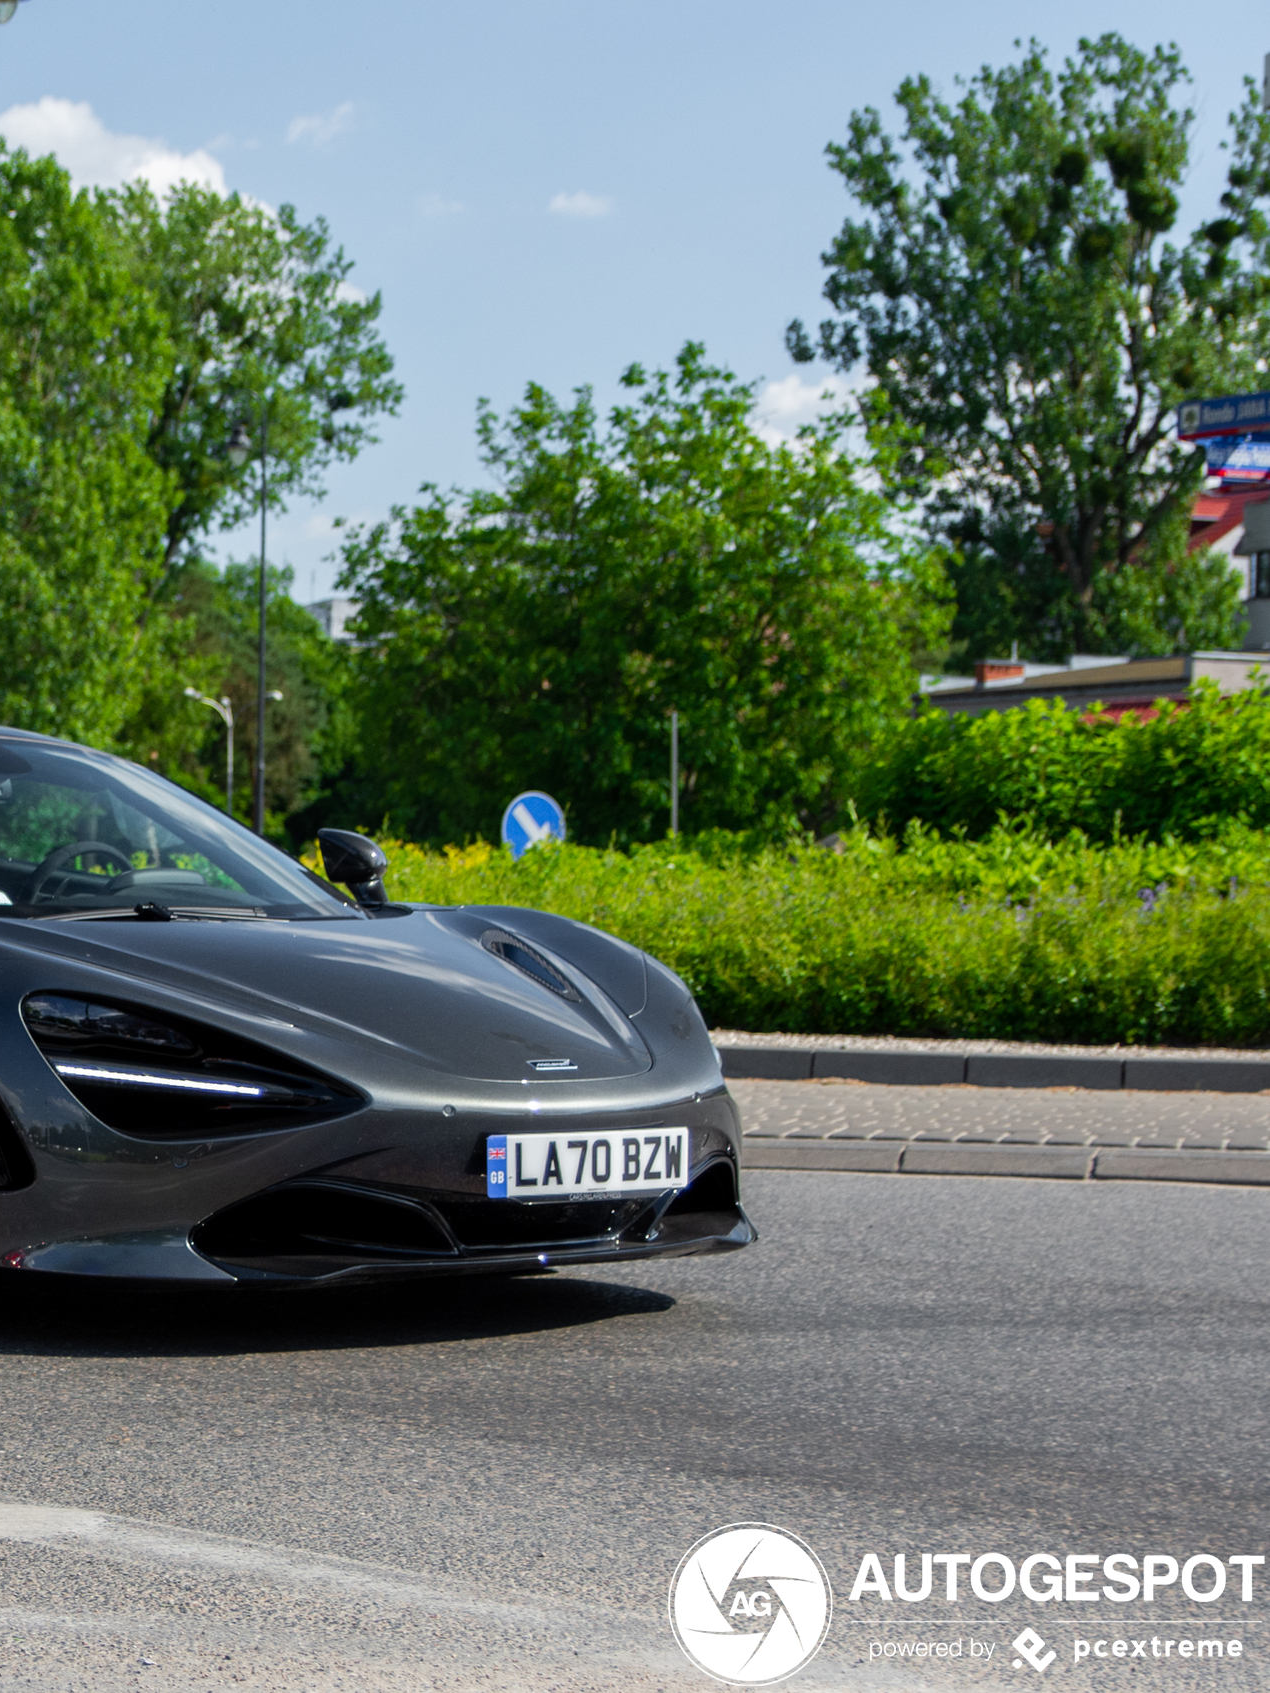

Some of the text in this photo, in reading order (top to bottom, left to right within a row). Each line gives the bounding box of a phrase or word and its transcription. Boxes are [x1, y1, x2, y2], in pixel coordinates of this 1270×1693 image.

[490, 1170, 505, 1184] GB
[515, 1135, 682, 1187] LA70 BZW
